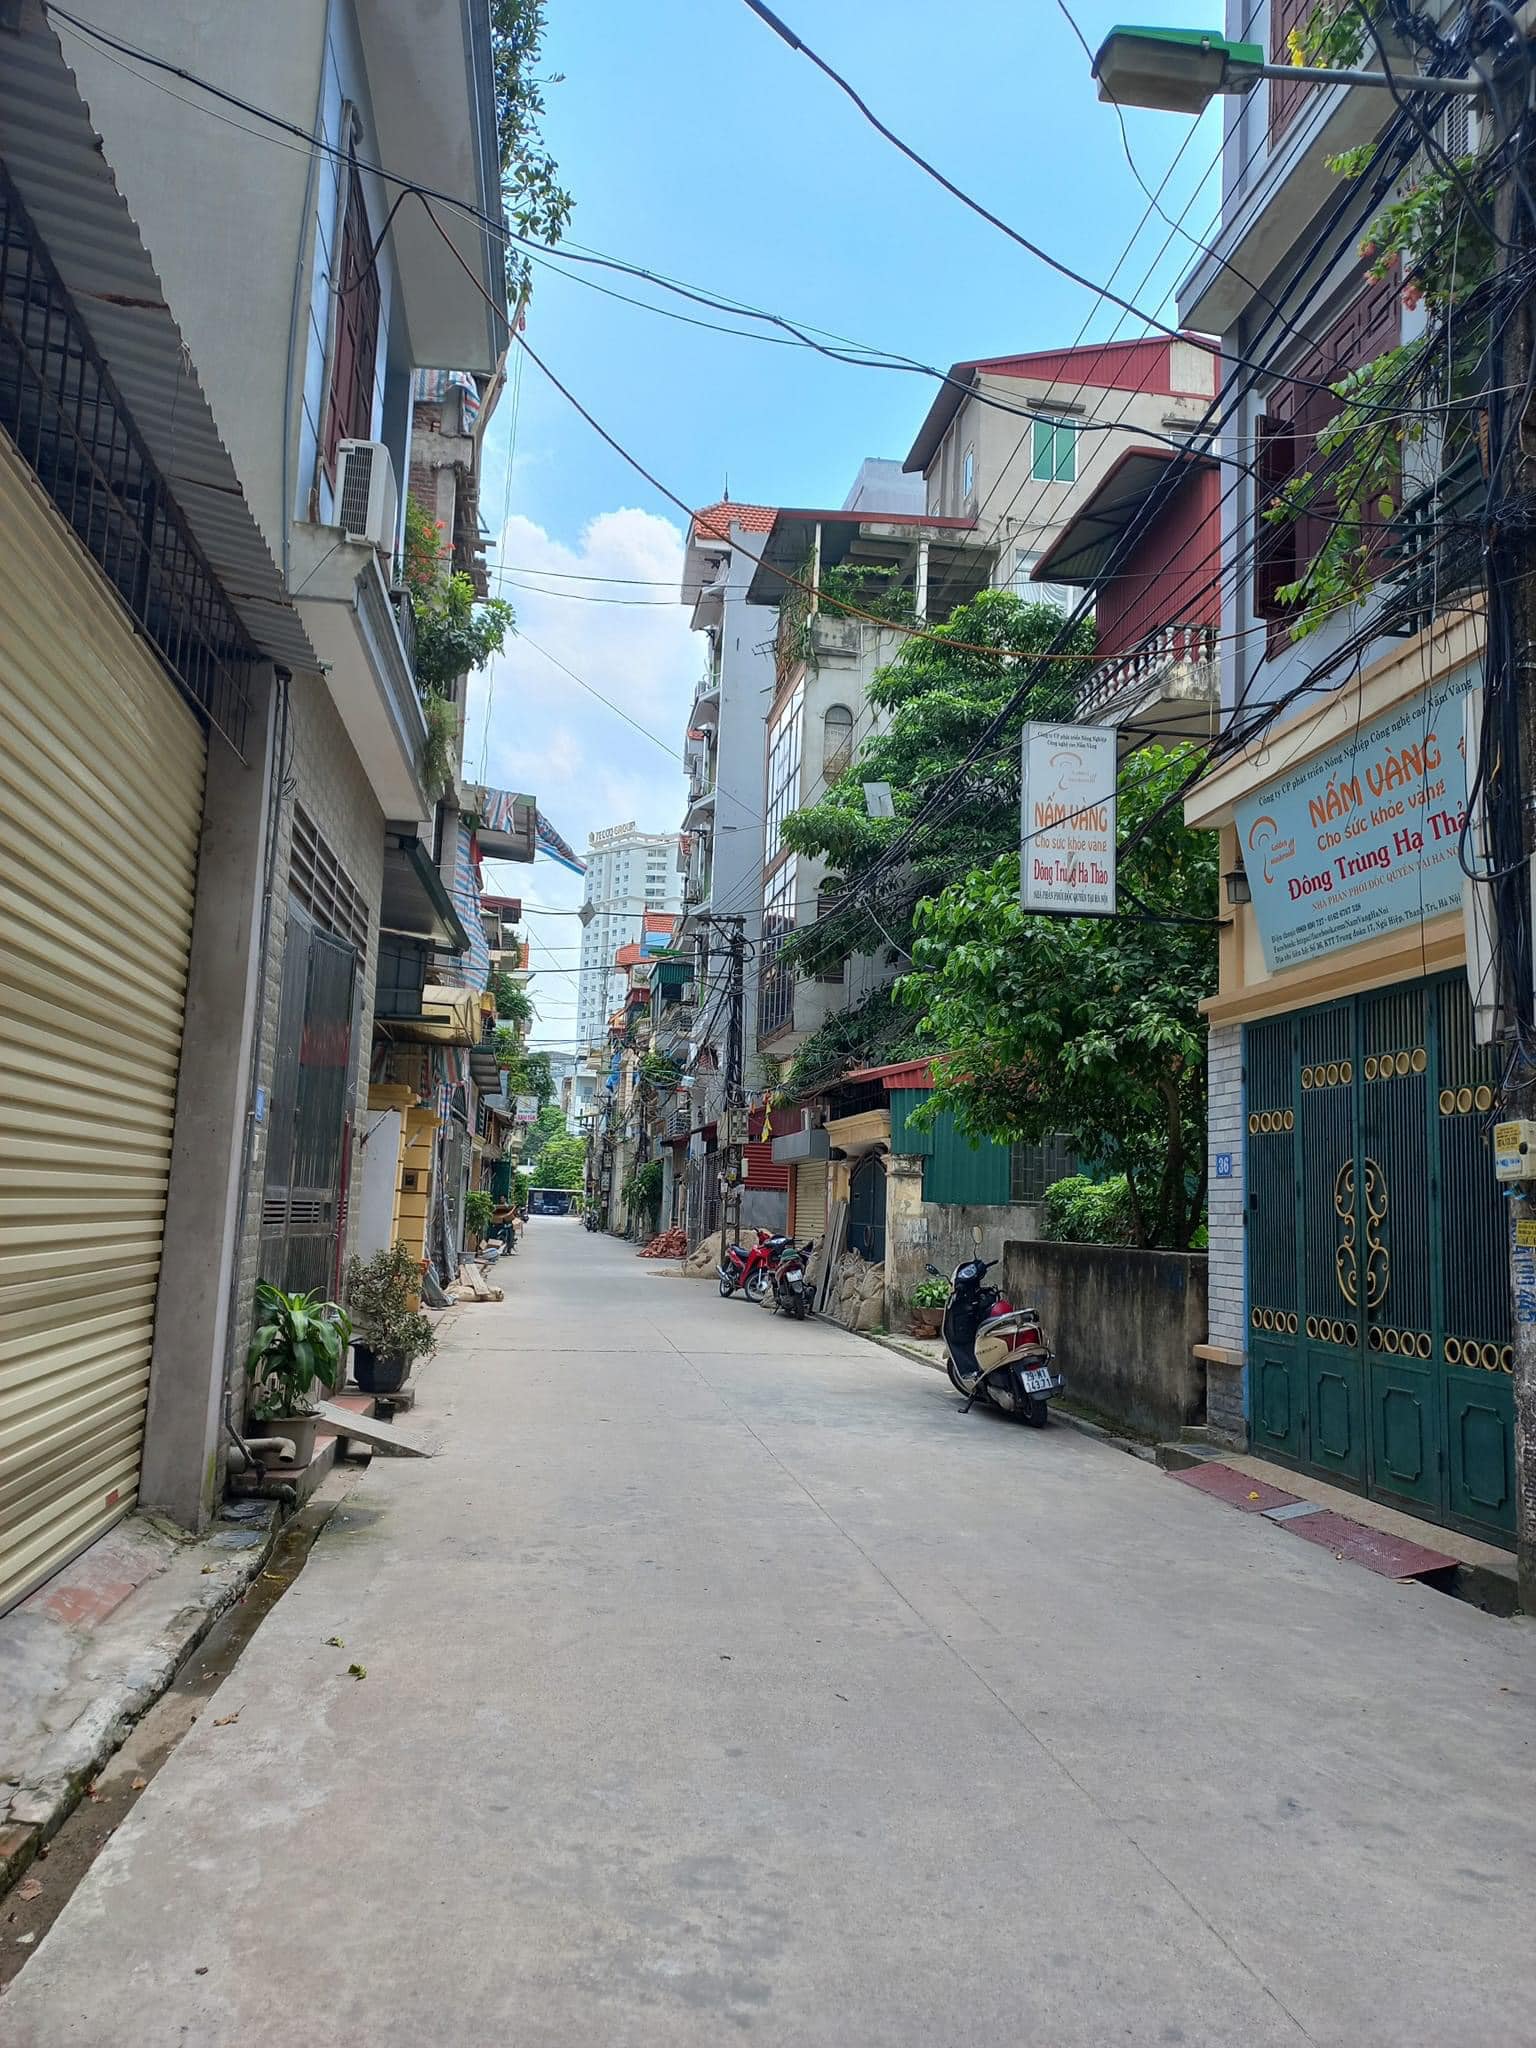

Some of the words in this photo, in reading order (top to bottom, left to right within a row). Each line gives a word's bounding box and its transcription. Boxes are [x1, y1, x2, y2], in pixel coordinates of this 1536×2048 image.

[1324, 754, 1343, 770] Nông
[1343, 739, 1370, 760] Nghiệp
[1370, 725, 1391, 743] Công
[1391, 712, 1411, 732] nghệ
[1412, 705, 1426, 720] cao
[1448, 678, 1472, 697] Vàng
[1308, 771, 1363, 828] NẤM
[1365, 733, 1441, 797] VÀNG
[1034, 792, 1066, 829] NẤM
[1070, 796, 1108, 832] VÀNG
[1317, 830, 1342, 851] Cho
[1345, 813, 1368, 839] sức
[1370, 798, 1405, 827] khỏe
[1407, 778, 1446, 808] vàng
[1034, 833, 1050, 848] Cho
[1288, 869, 1333, 901] Đông
[1334, 845, 1391, 880] Trùng
[1393, 828, 1424, 857] Hạ
[1426, 799, 1468, 841] Thả
[1034, 858, 1053, 886] Đông
[1078, 862, 1088, 888] Hạ
[1090, 861, 1108, 885] Thảo
[1218, 1156, 1229, 1174] 36
